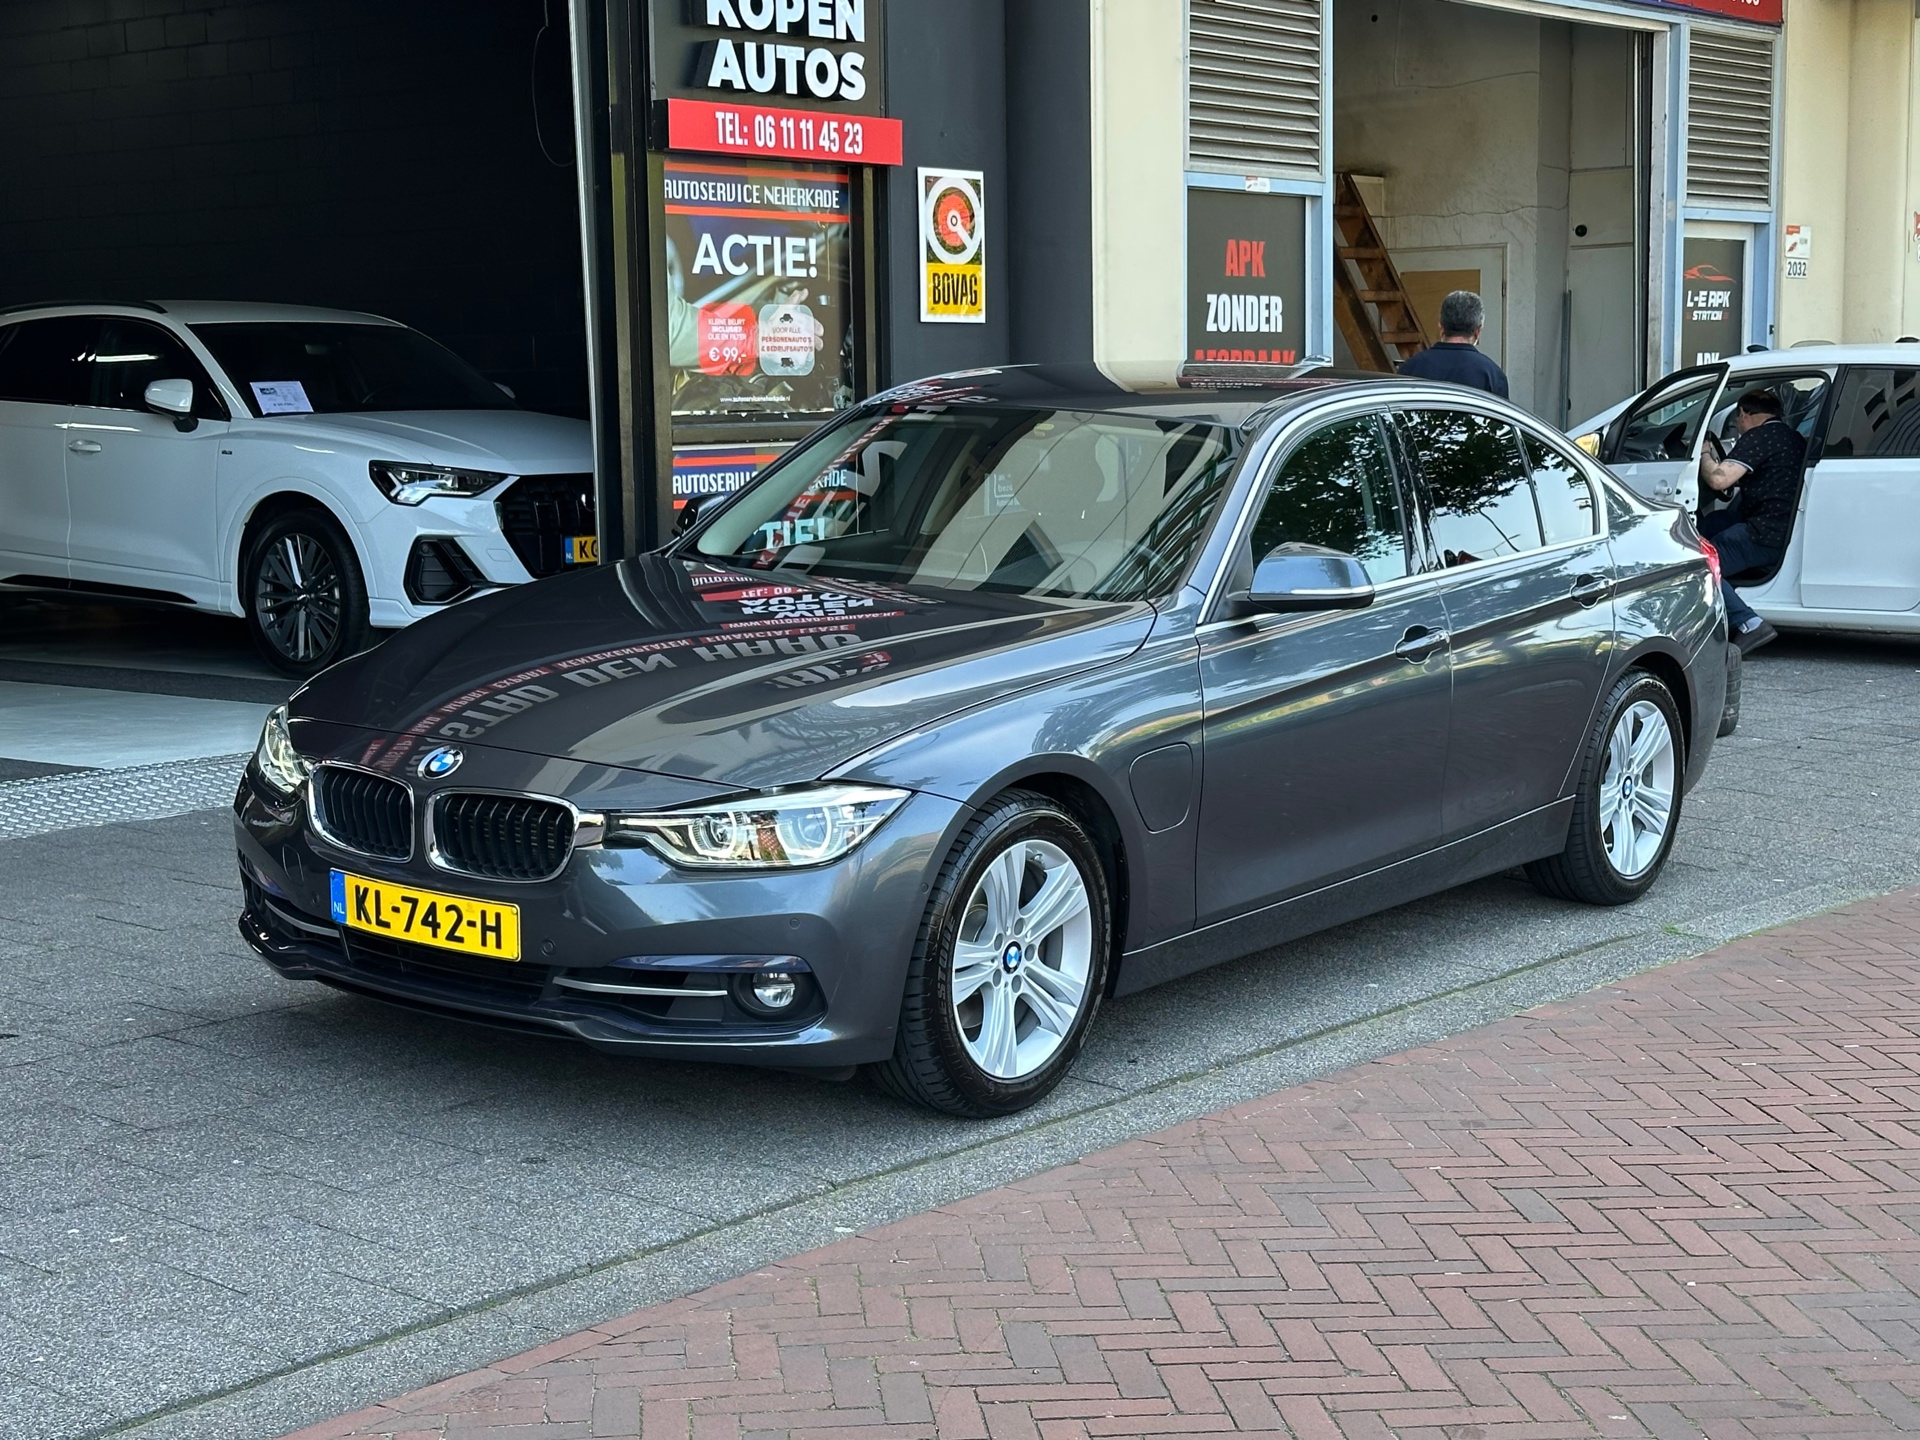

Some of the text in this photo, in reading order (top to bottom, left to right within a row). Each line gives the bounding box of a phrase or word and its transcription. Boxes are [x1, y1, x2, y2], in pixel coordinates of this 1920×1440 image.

[706, 0, 865, 42] KOPEN
[707, 38, 866, 101] AUTOS
[715, 111, 863, 155] TEL: 06 11 11 45 23
[664, 179, 840, 209] AUTOSERVICE NEHERKADE
[692, 233, 818, 278] ACTIE!
[1225, 239, 1265, 277] APK
[1787, 261, 1807, 276] 2032
[932, 272, 978, 306] BOVAG
[1708, 291, 1731, 307] APK
[1206, 293, 1282, 332] ZONDER
[1692, 310, 1723, 321] STATION
[709, 347, 720, 362] €
[333, 901, 345, 915] NL
[354, 884, 502, 950] KL-742-H
